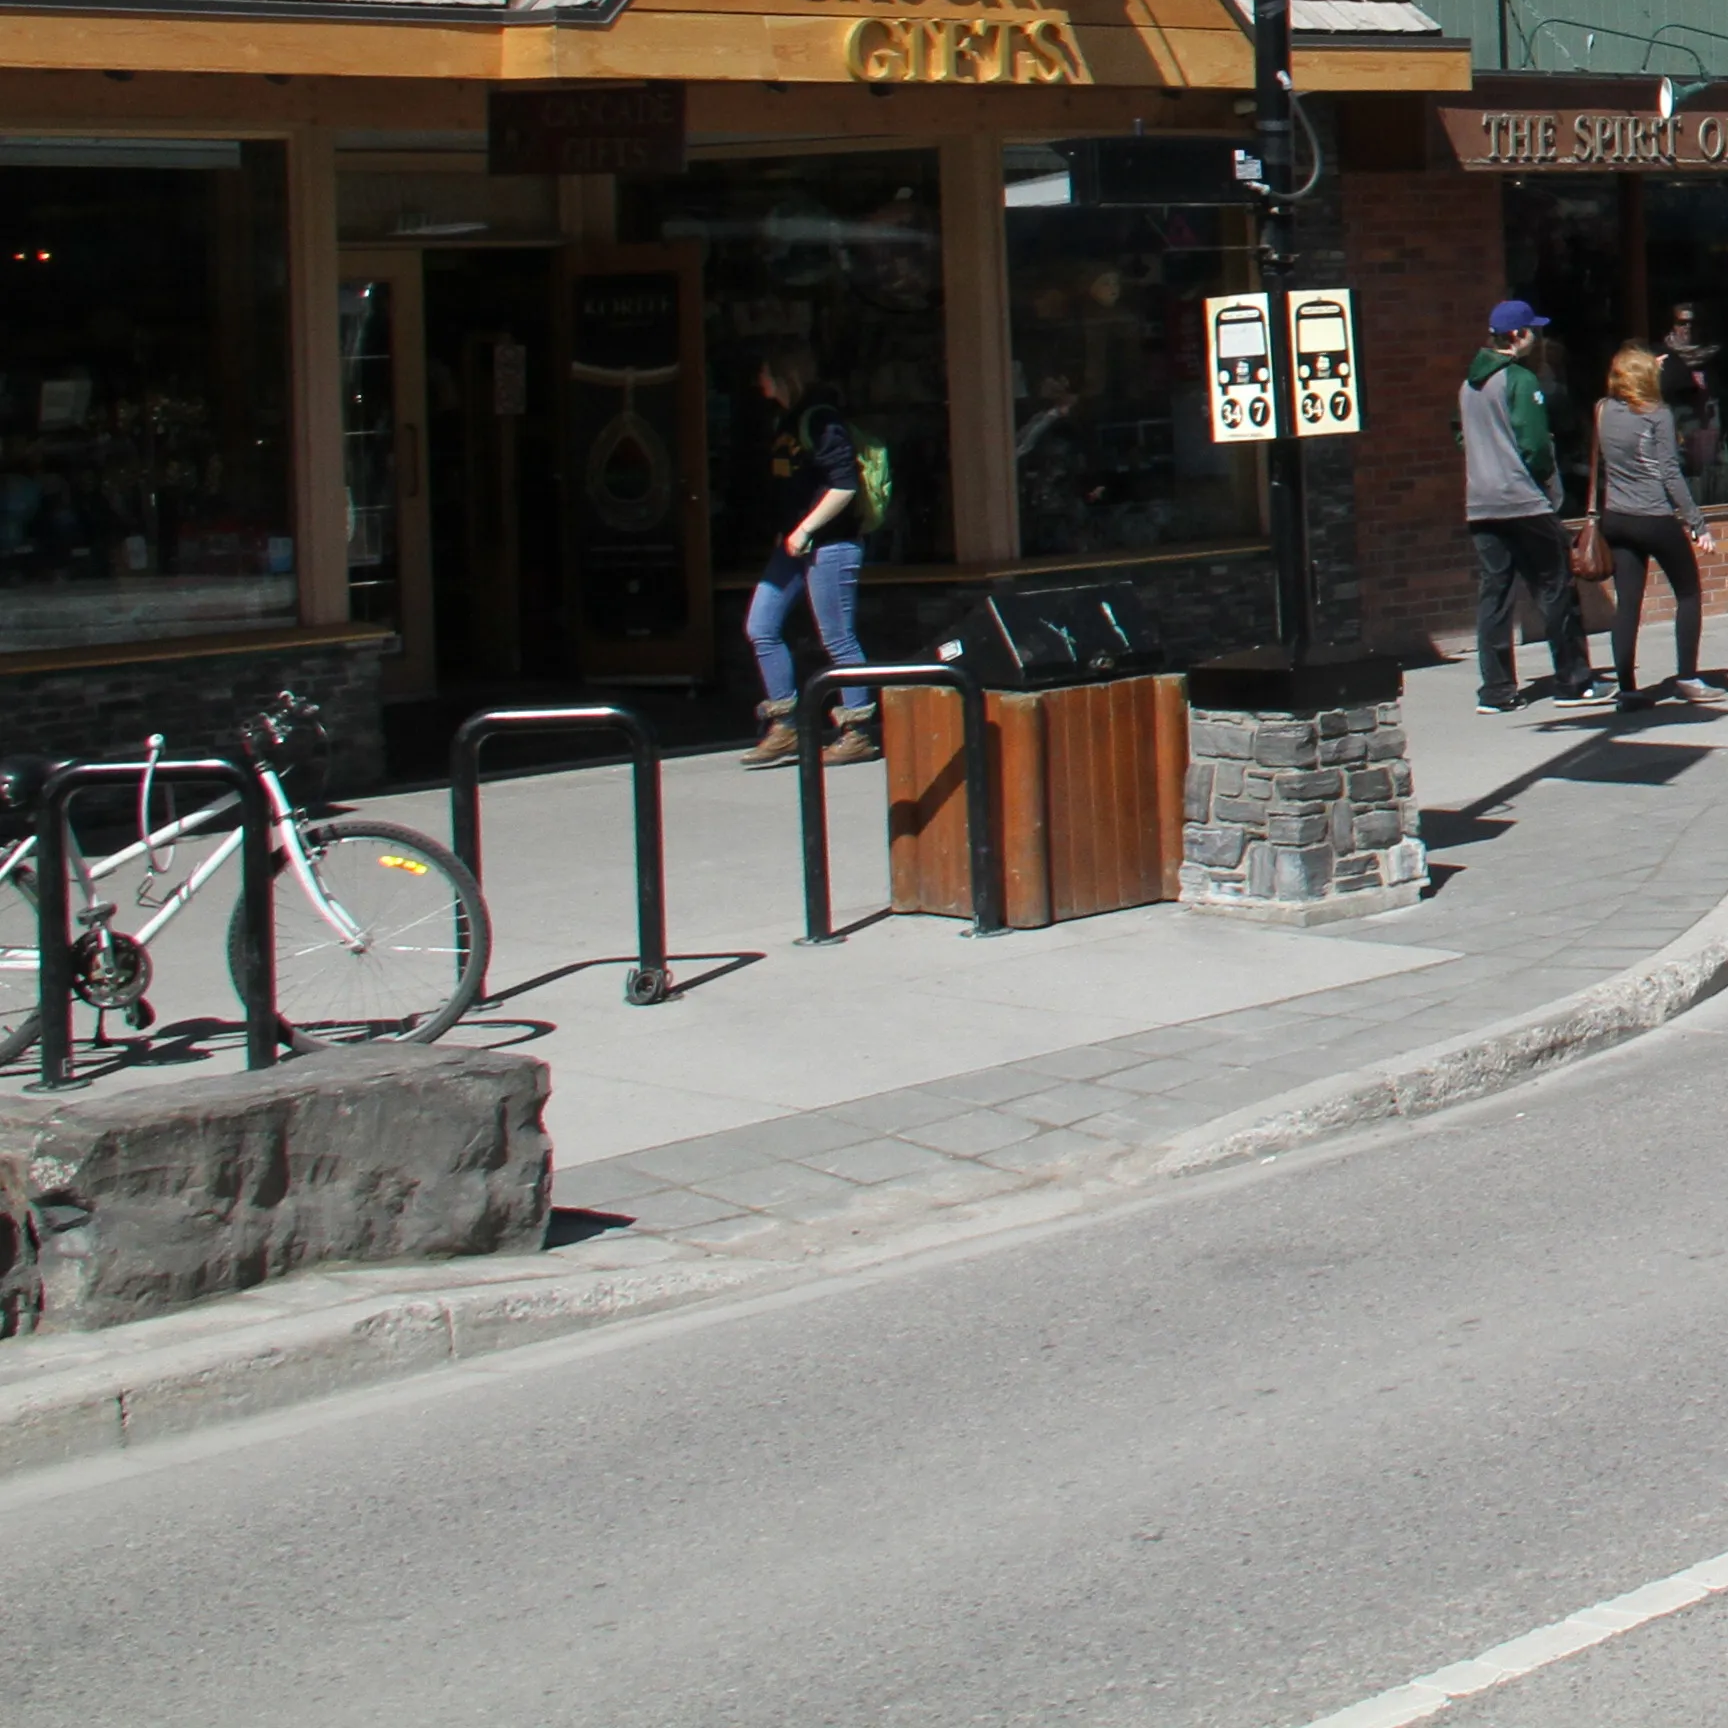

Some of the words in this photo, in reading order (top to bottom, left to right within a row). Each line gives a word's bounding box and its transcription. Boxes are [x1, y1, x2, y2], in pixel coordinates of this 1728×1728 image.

[844, 16, 1064, 84] GIFTS
[1482, 112, 1557, 163] THE
[1573, 114, 1682, 164] SPIRIT
[1253, 402, 1265, 423] 7
[1334, 396, 1346, 416] 7
